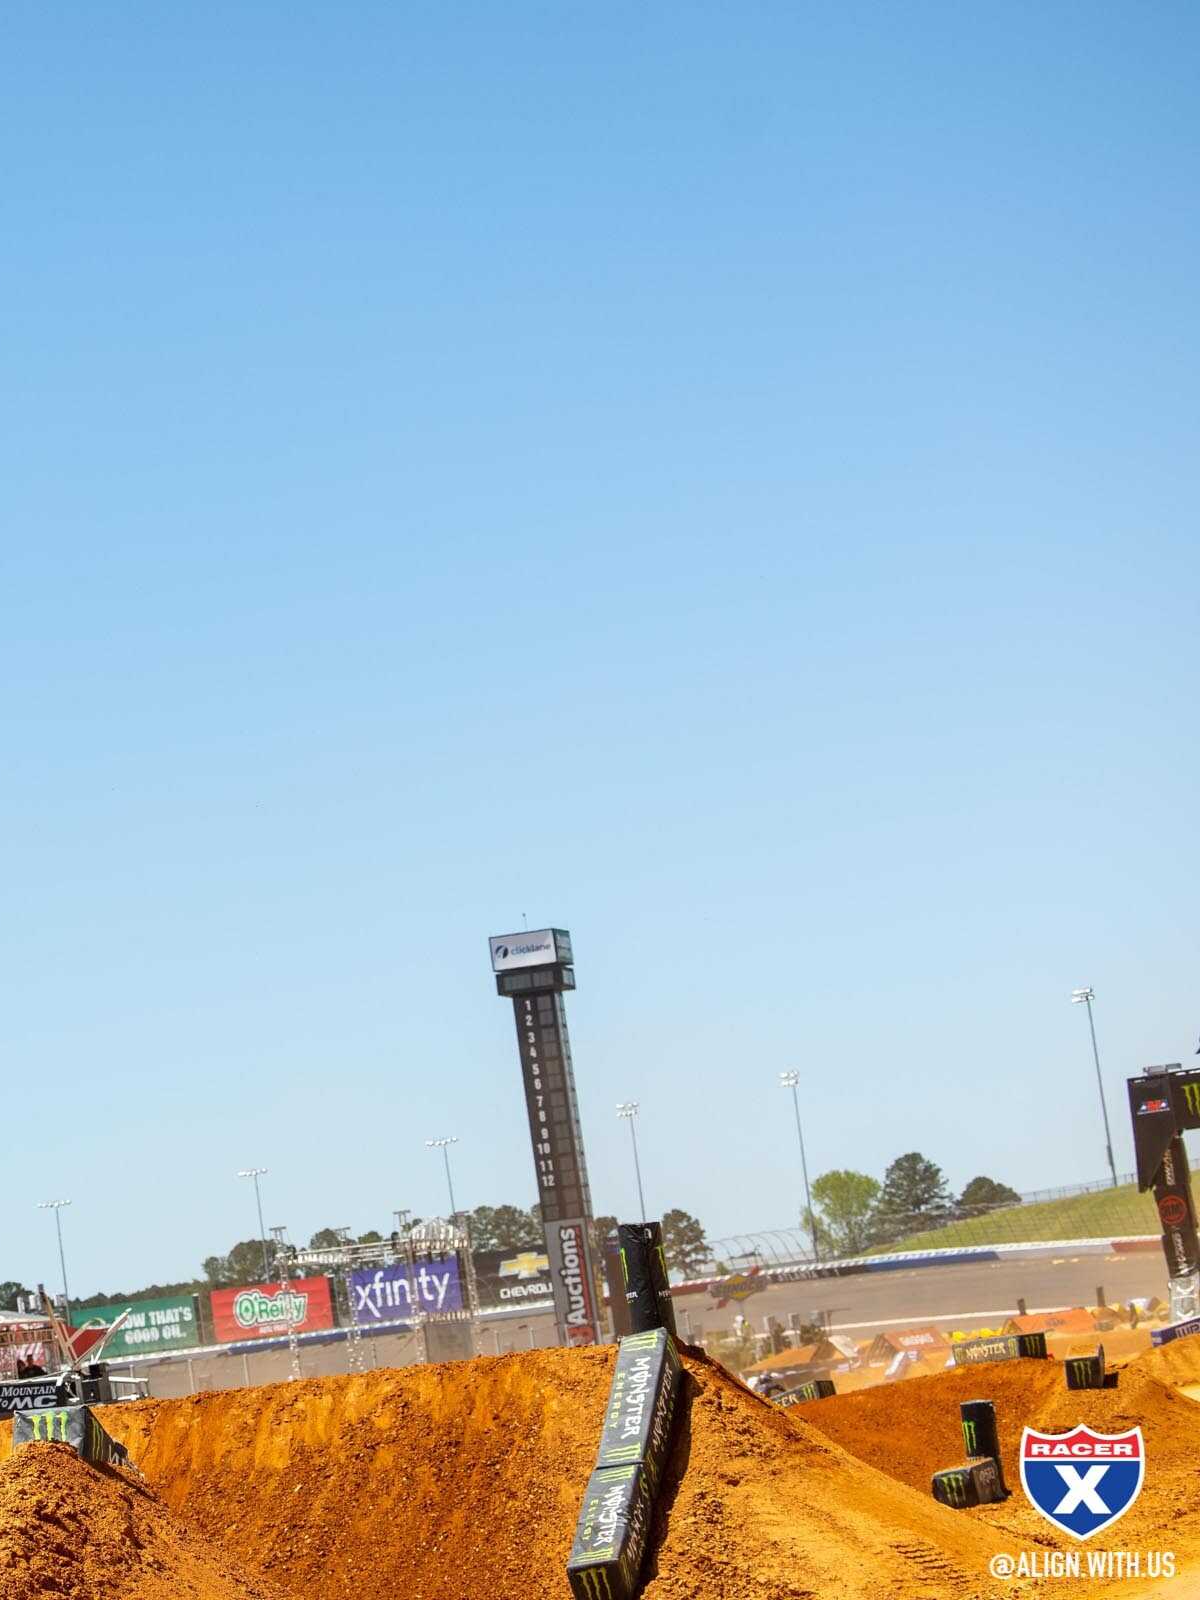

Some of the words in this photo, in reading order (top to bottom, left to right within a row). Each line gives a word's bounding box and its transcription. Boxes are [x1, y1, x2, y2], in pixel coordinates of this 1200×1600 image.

[525, 1001, 531, 1011] 1
[526, 1015, 533, 1026] 2
[528, 1032, 535, 1043] 3
[530, 1047, 537, 1058] 4
[532, 1064, 540, 1075] 5
[534, 1079, 541, 1090] 6
[536, 1096, 543, 1107] 7
[539, 1111, 546, 1122] 8
[541, 1128, 548, 1139] 9
[537, 1143, 550, 1154] 10
[540, 1160, 553, 1171] 11
[542, 1175, 555, 1187] 12
[559, 1227, 587, 1325] Auctions
[500, 1282, 553, 1299] CHEVROL
[150, 1307, 192, 1324] THAT'S
[125, 1329, 159, 1344] GOOD
[1, 1385, 56, 1397] MOUNTAIN
[611, 1372, 625, 1430] ENERGY
[622, 1356, 651, 1440] MONSTER
